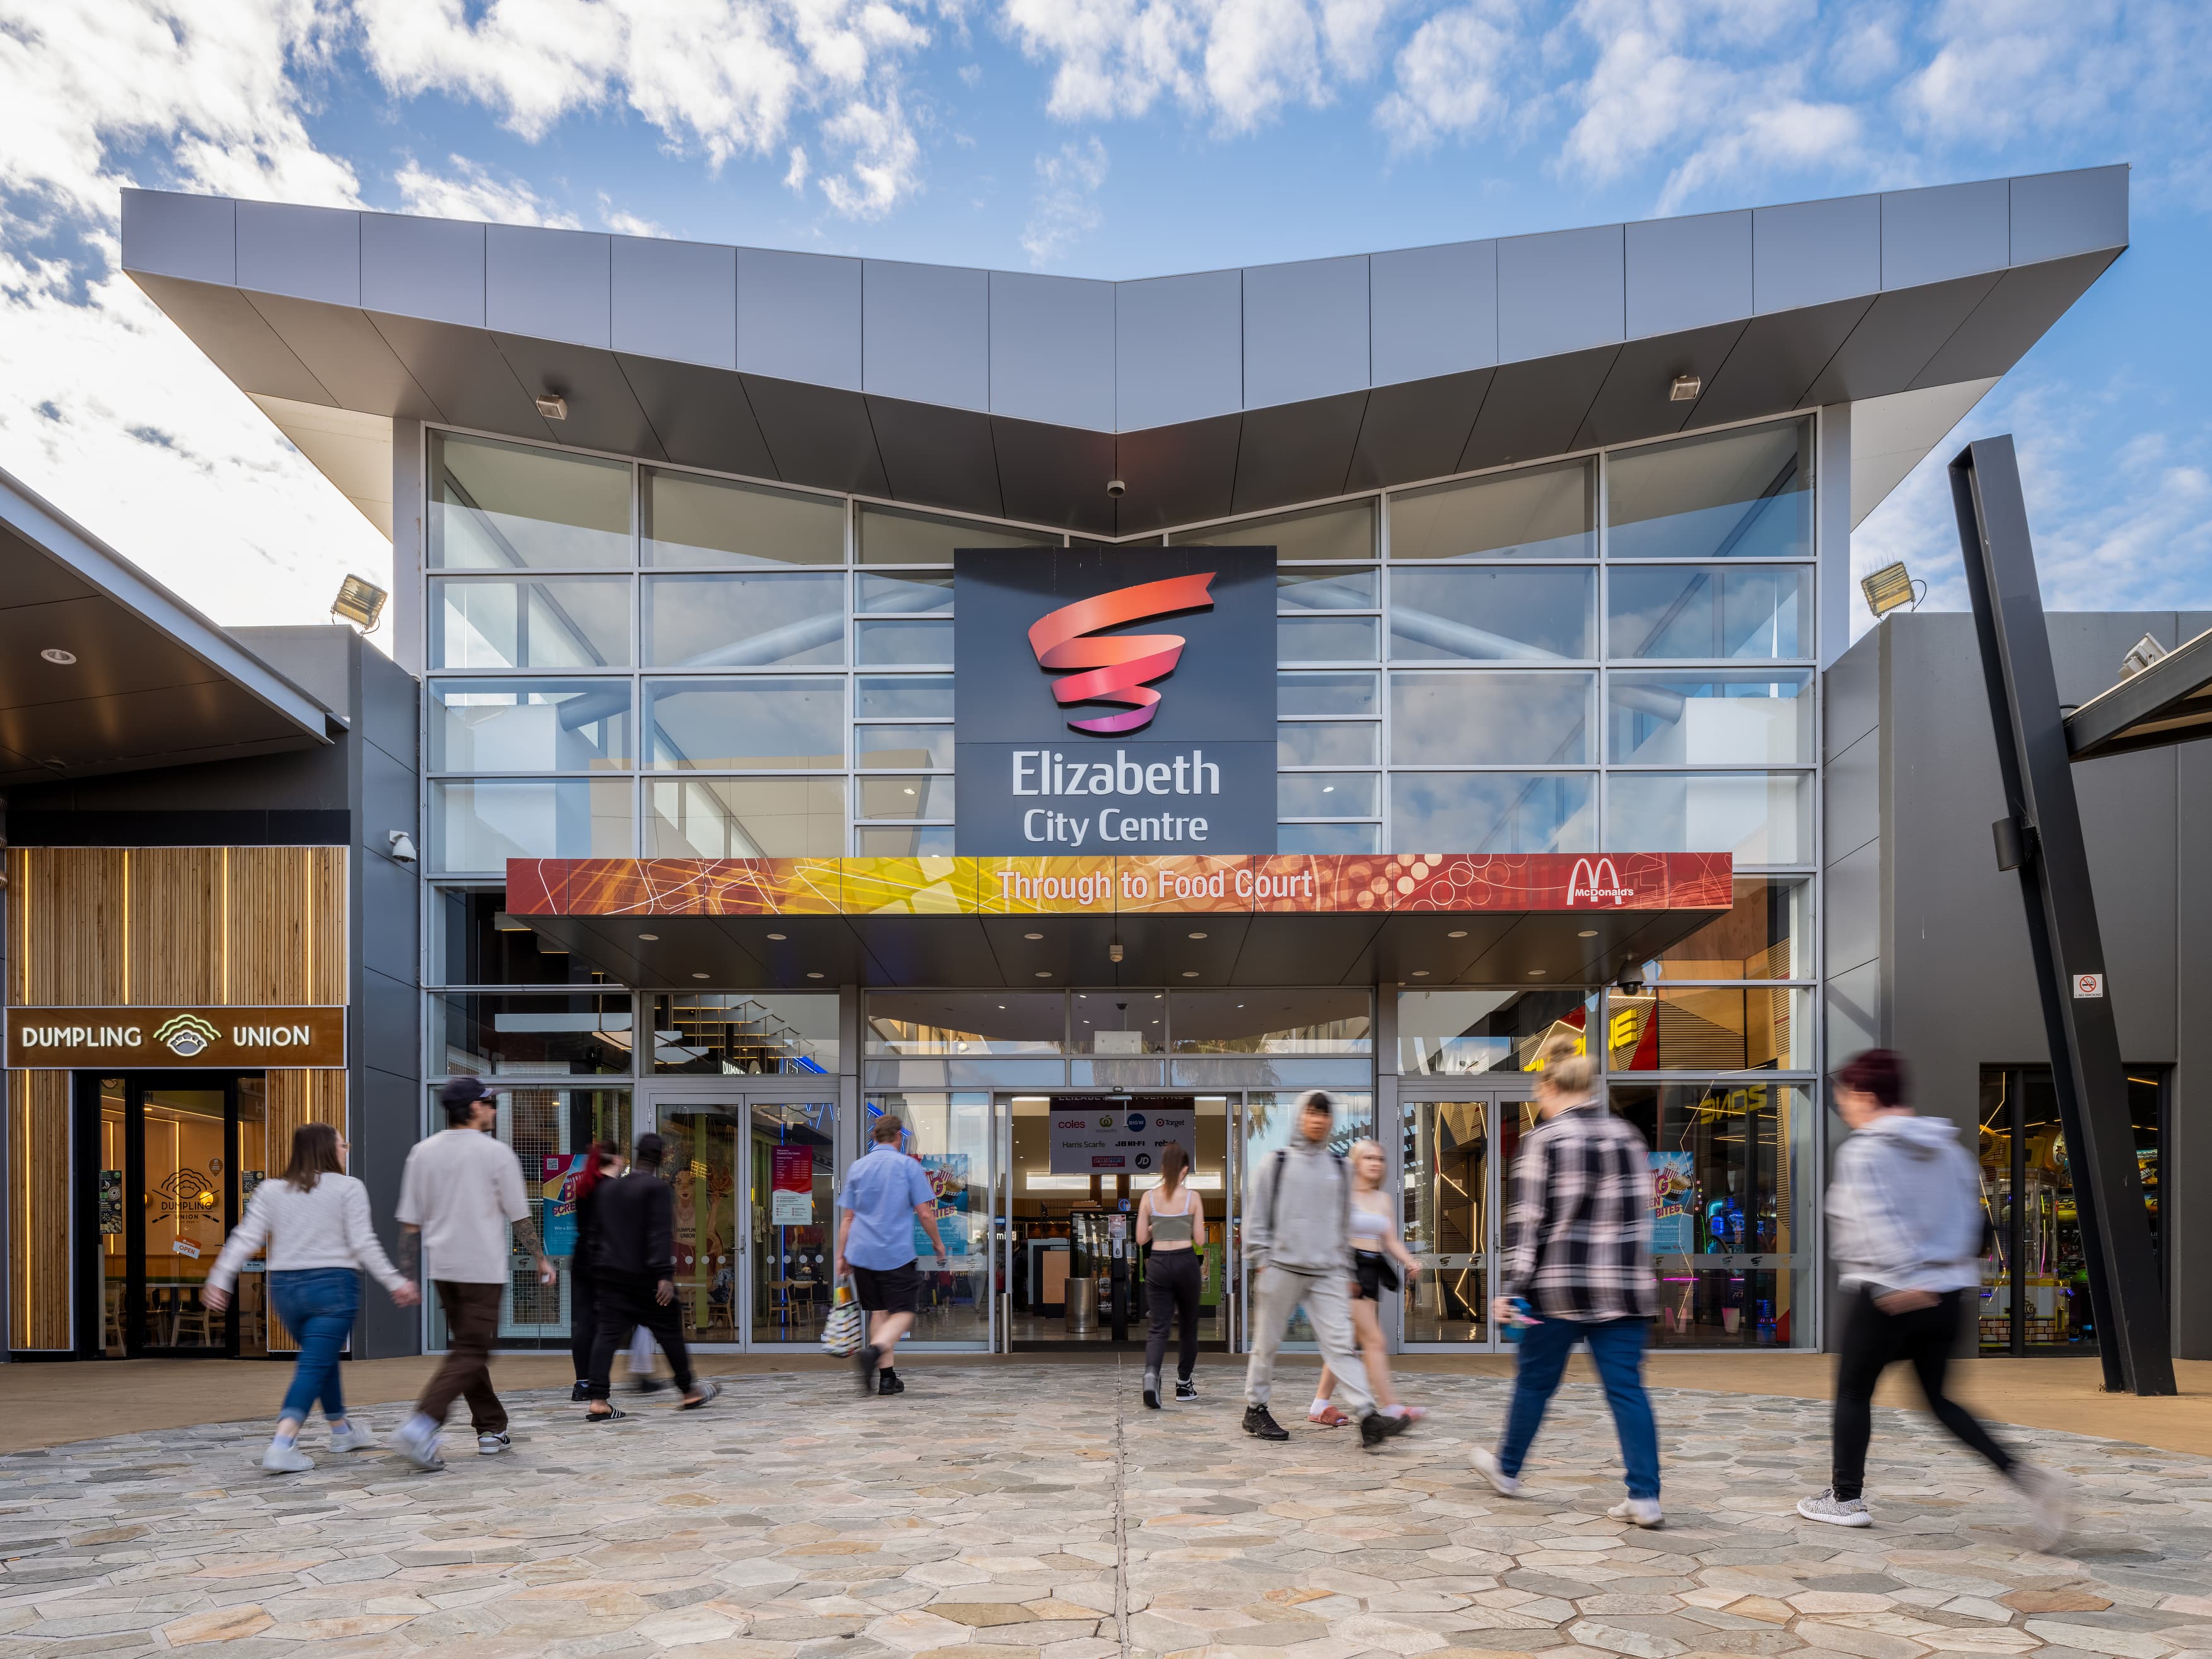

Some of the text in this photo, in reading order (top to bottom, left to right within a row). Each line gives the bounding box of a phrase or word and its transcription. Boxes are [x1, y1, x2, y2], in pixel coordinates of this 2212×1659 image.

[1013, 750, 1220, 796] Elizabeth
[1023, 808, 1208, 847] City Centre
[998, 870, 1312, 904] Through to Food Court
[22, 1026, 310, 1047] DUMPLING UNION
[1059, 1120, 1085, 1129] coles
[1165, 1119, 1185, 1127] Target
[161, 1201, 212, 1211] DUMPLING
[552, 1202, 576, 1217] SCRE
[1656, 1204, 1683, 1219] BITES
[178, 1245, 196, 1255] OPEN
